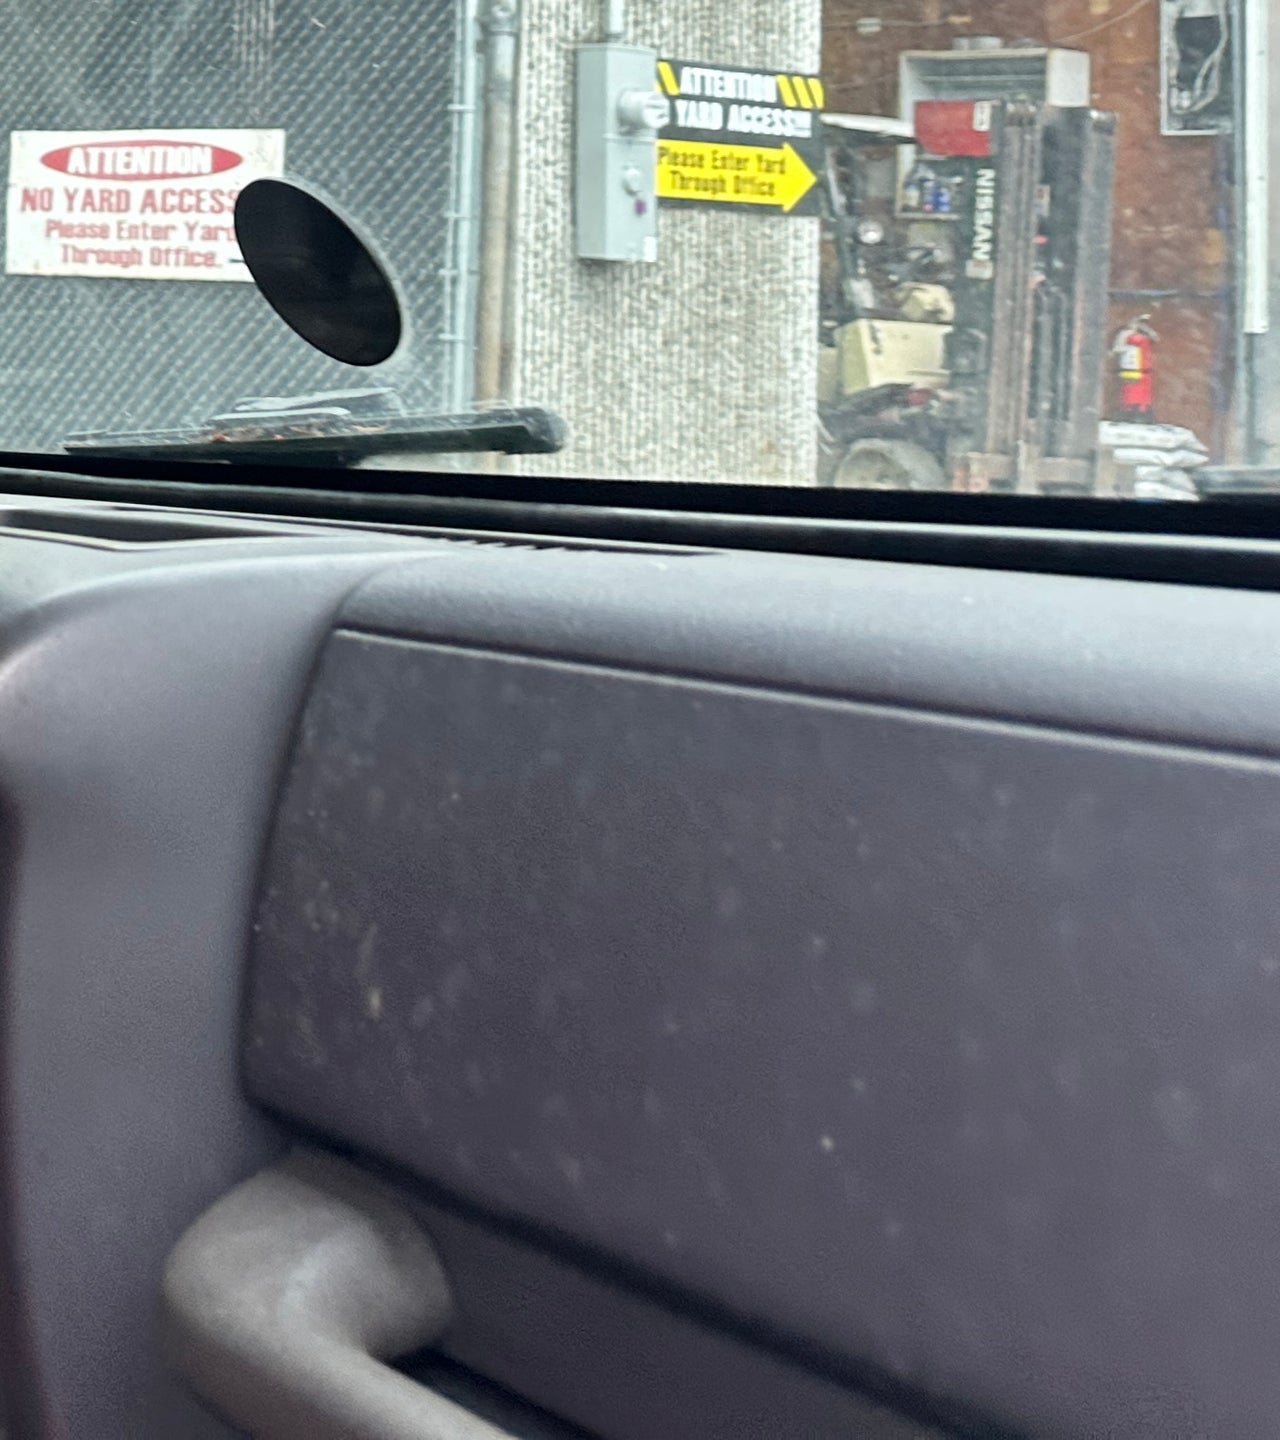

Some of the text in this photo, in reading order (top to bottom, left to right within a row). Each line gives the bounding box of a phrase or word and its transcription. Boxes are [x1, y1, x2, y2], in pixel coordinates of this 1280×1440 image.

[67, 146, 212, 175] ATTENTION
[657, 146, 705, 170] Please
[20, 186, 239, 214] NO YARD ACCESS
[972, 168, 996, 260] NISSAN
[45, 219, 110, 239] Please
[116, 220, 178, 241] Enter
[61, 244, 143, 269] Through
